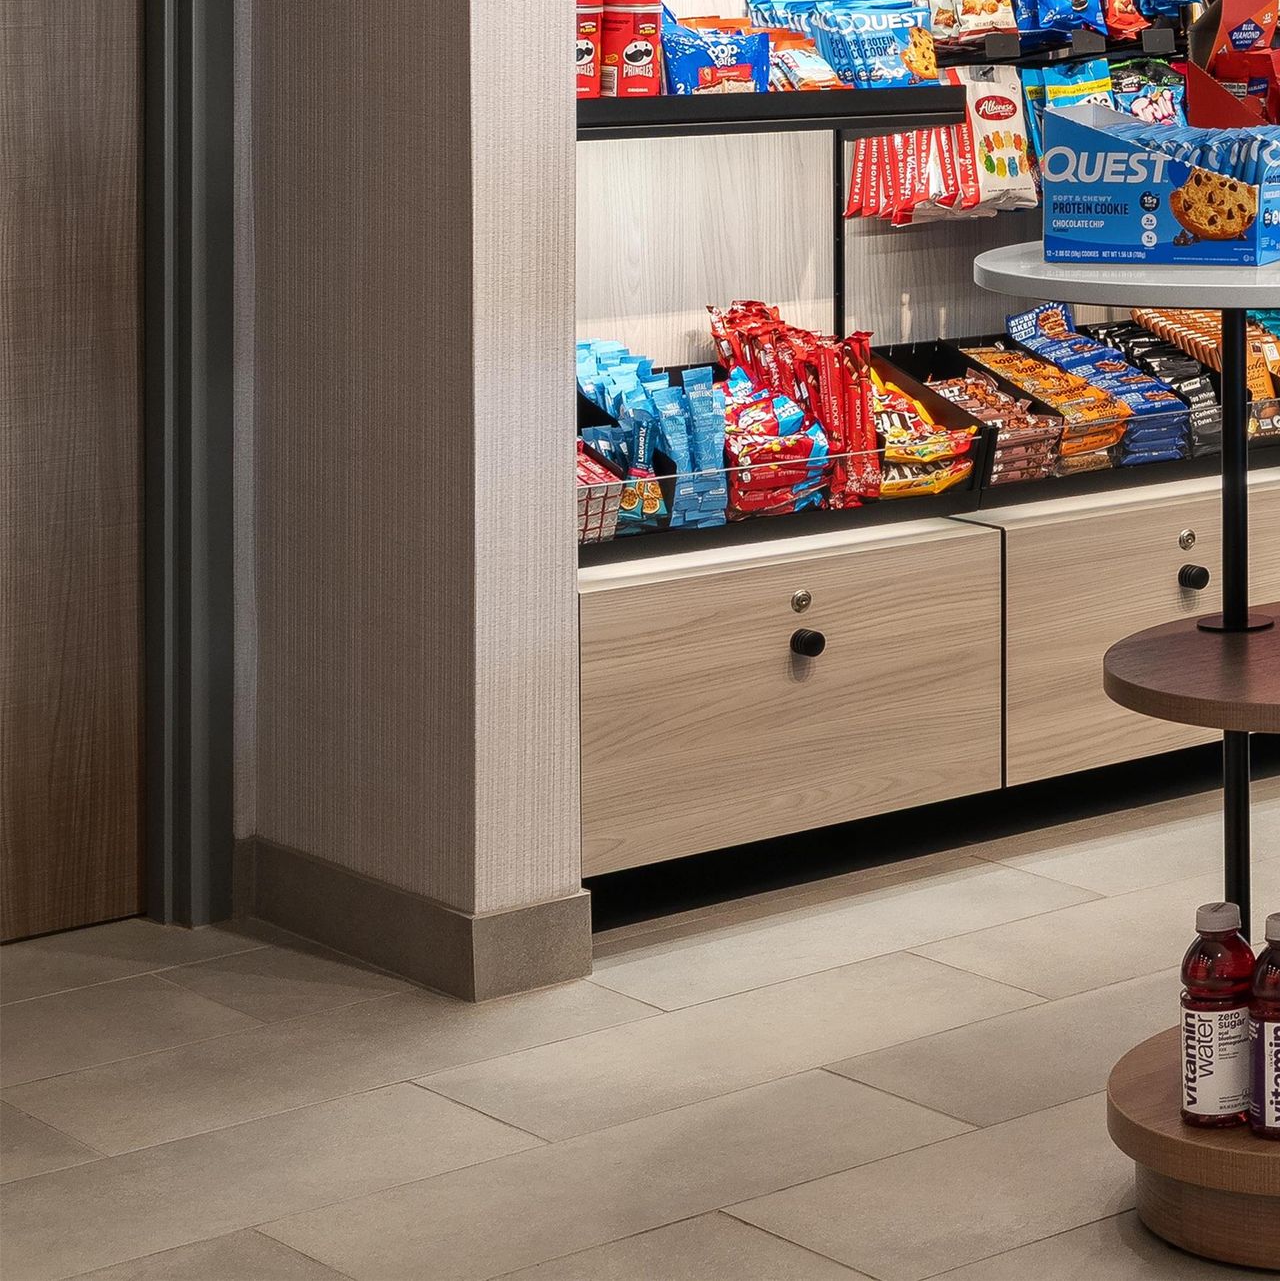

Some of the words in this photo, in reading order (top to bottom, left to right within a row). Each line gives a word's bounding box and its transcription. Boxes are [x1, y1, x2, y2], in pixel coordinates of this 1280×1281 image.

[1232, 30, 1261, 40] DIAMOND
[623, 63, 654, 78] PRINGLES
[1044, 145, 1169, 184] QUEST
[1052, 203, 1093, 215] PROTEIN
[1095, 204, 1129, 216] COOKIE
[1052, 220, 1089, 228] CHOCOLATE
[1090, 220, 1105, 229] CHIP
[1217, 1012, 1240, 1021] zero
[1218, 1017, 1246, 1030] sugar
[1197, 1013, 1214, 1079] water
